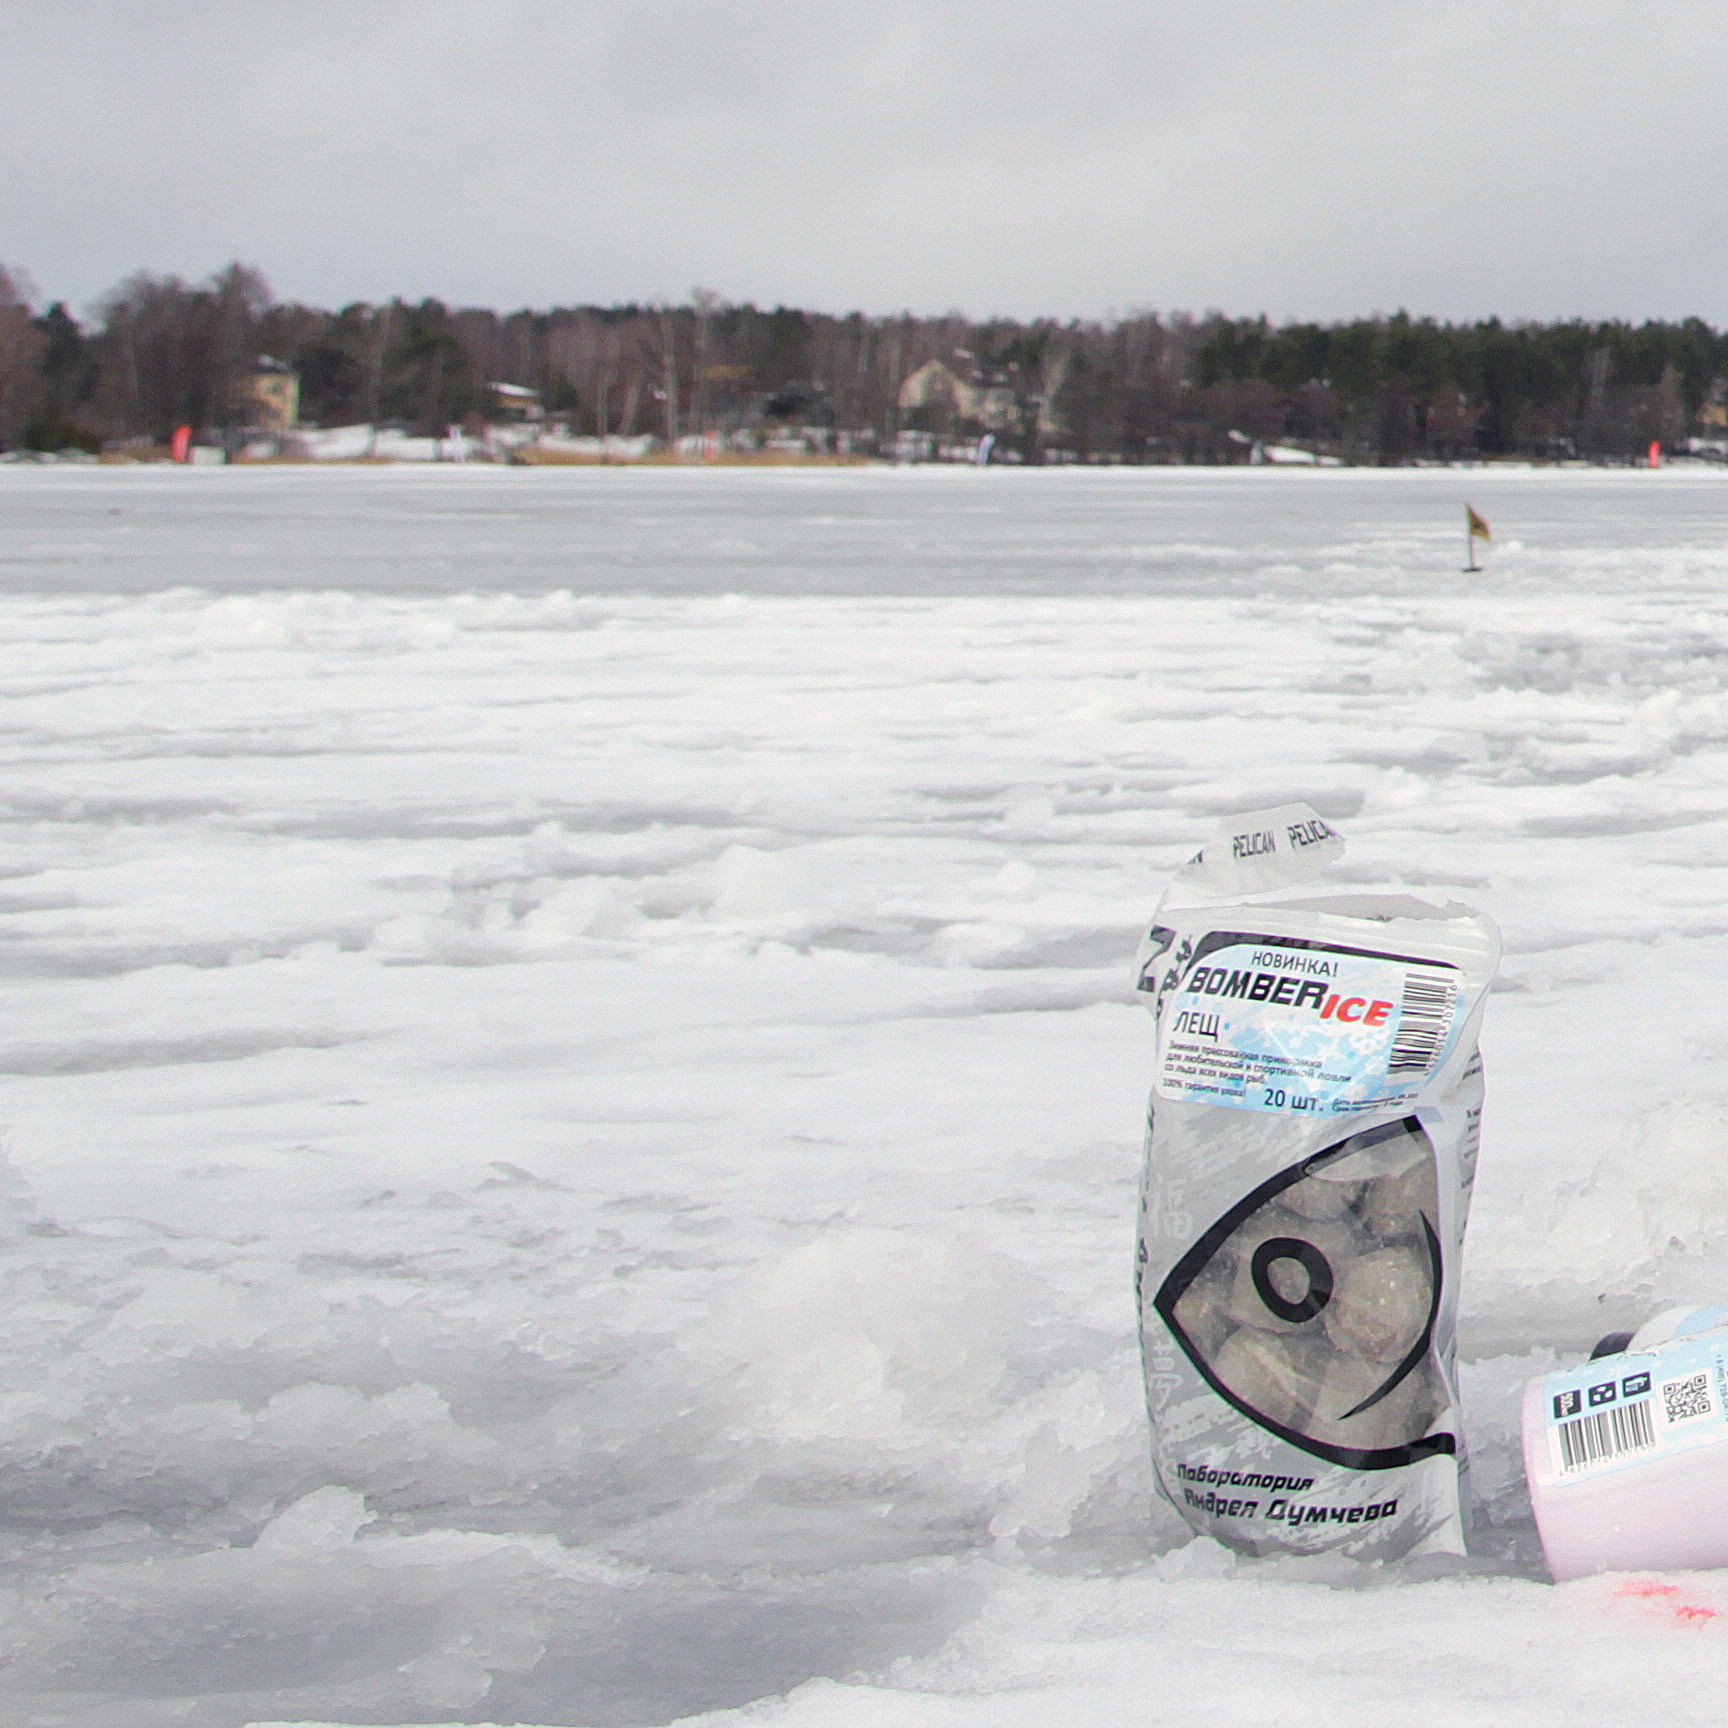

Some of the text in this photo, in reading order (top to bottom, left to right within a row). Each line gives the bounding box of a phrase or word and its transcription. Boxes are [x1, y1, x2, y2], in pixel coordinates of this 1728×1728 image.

[1233, 830, 1276, 858] PELICAN
[1251, 950, 1338, 977] НОВИНКА!
[1173, 1012, 1220, 1043] ЛЕЩ
[1264, 1087, 1286, 1107] 20
[1291, 1094, 1324, 1112] шт.
[1178, 1463, 1314, 1492] Лаборатория
[1184, 1487, 1398, 1527] Андрея Думчева
